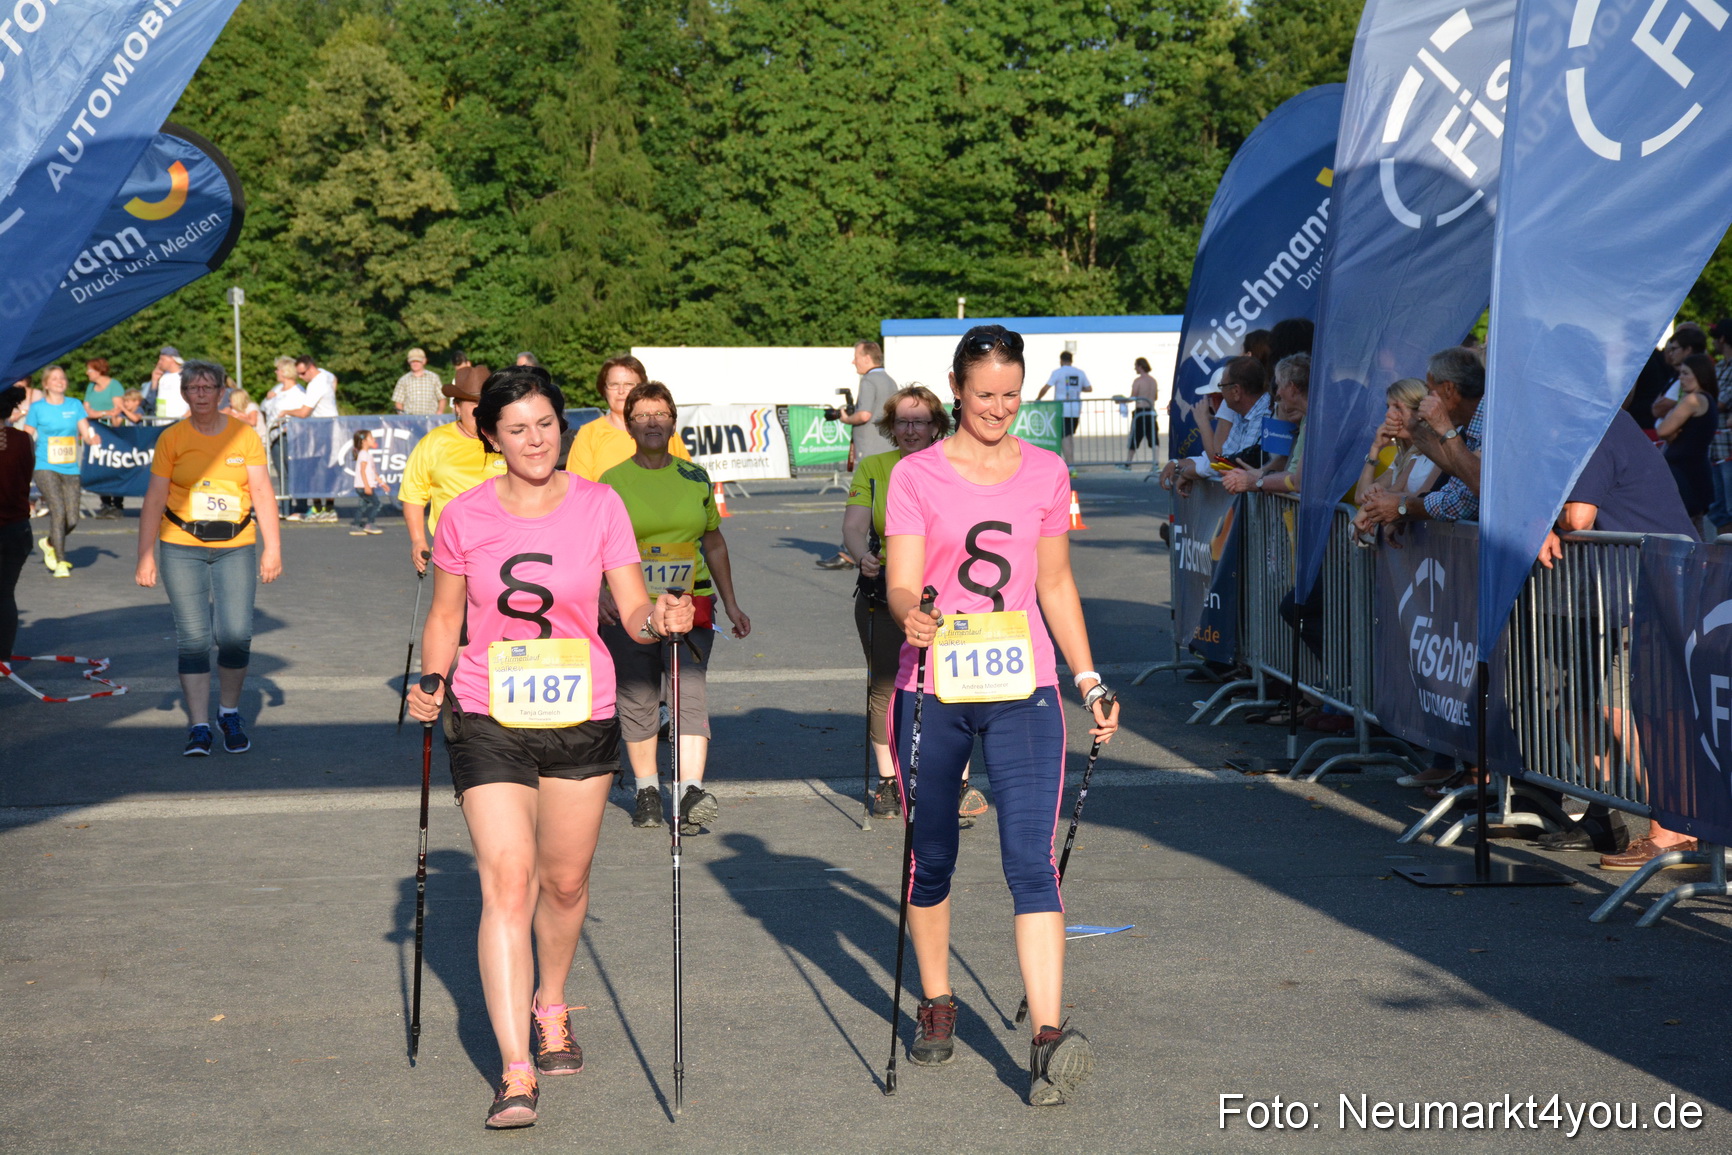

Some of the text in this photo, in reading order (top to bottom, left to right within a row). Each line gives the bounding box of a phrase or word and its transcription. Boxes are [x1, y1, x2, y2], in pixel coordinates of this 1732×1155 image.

[70, 212, 222, 304] Druck und Medien
[801, 416, 851, 445] AOK
[1013, 409, 1057, 438] AOK
[52, 448, 74, 456] 1098
[681, 424, 747, 457] swn
[731, 456, 769, 469] neumarkt
[207, 496, 227, 511] 56
[644, 564, 691, 582] 1177
[945, 646, 1024, 677] 1188
[501, 674, 582, 703] 1187
